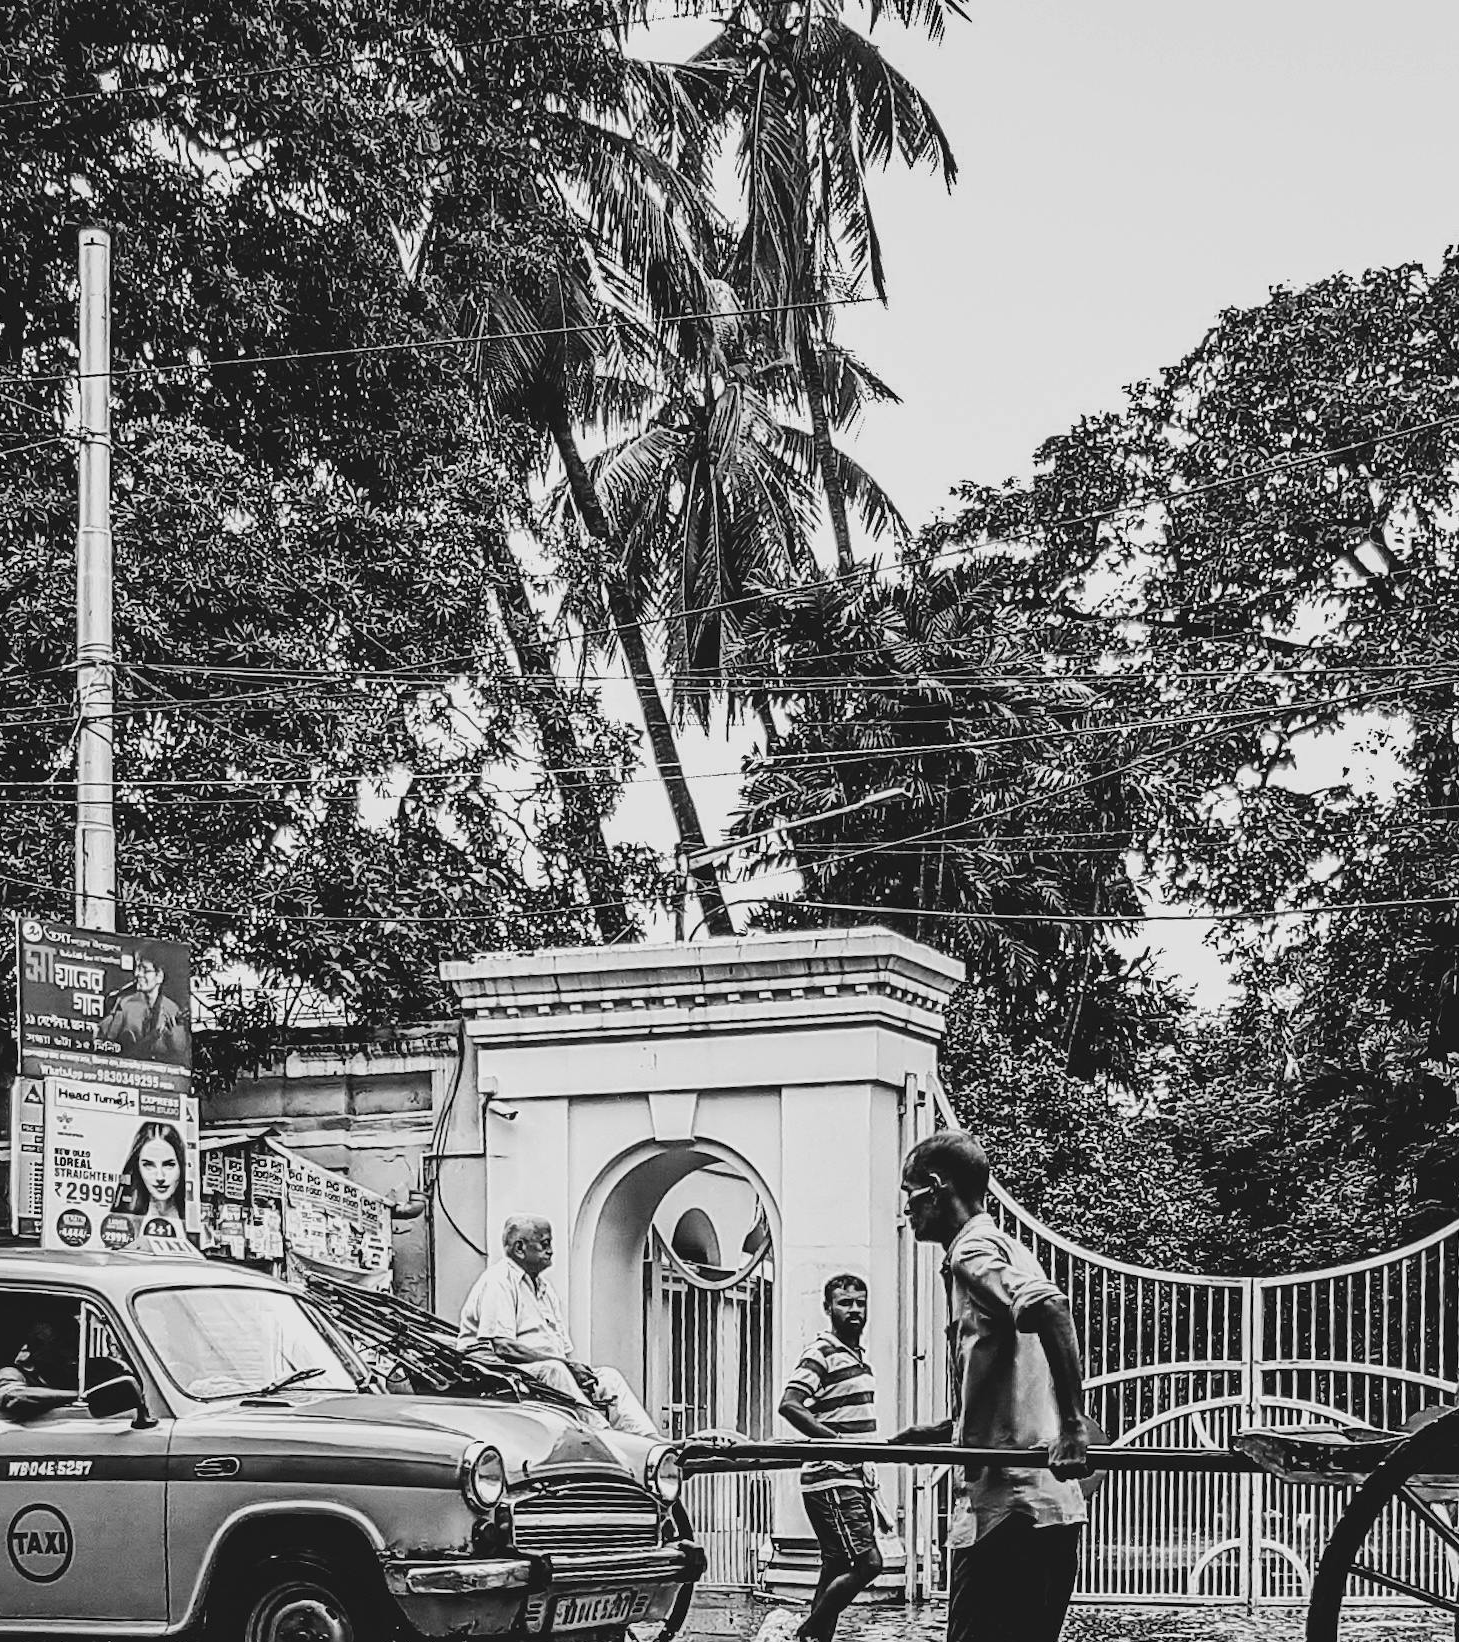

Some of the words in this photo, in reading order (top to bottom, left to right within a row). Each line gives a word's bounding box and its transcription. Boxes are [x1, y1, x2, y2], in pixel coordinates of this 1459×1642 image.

[73, 991, 105, 1018] গান
[59, 1087, 90, 1102] Head
[147, 1221, 172, 1237] 2+1
[12, 1532, 66, 1555] TAXI
